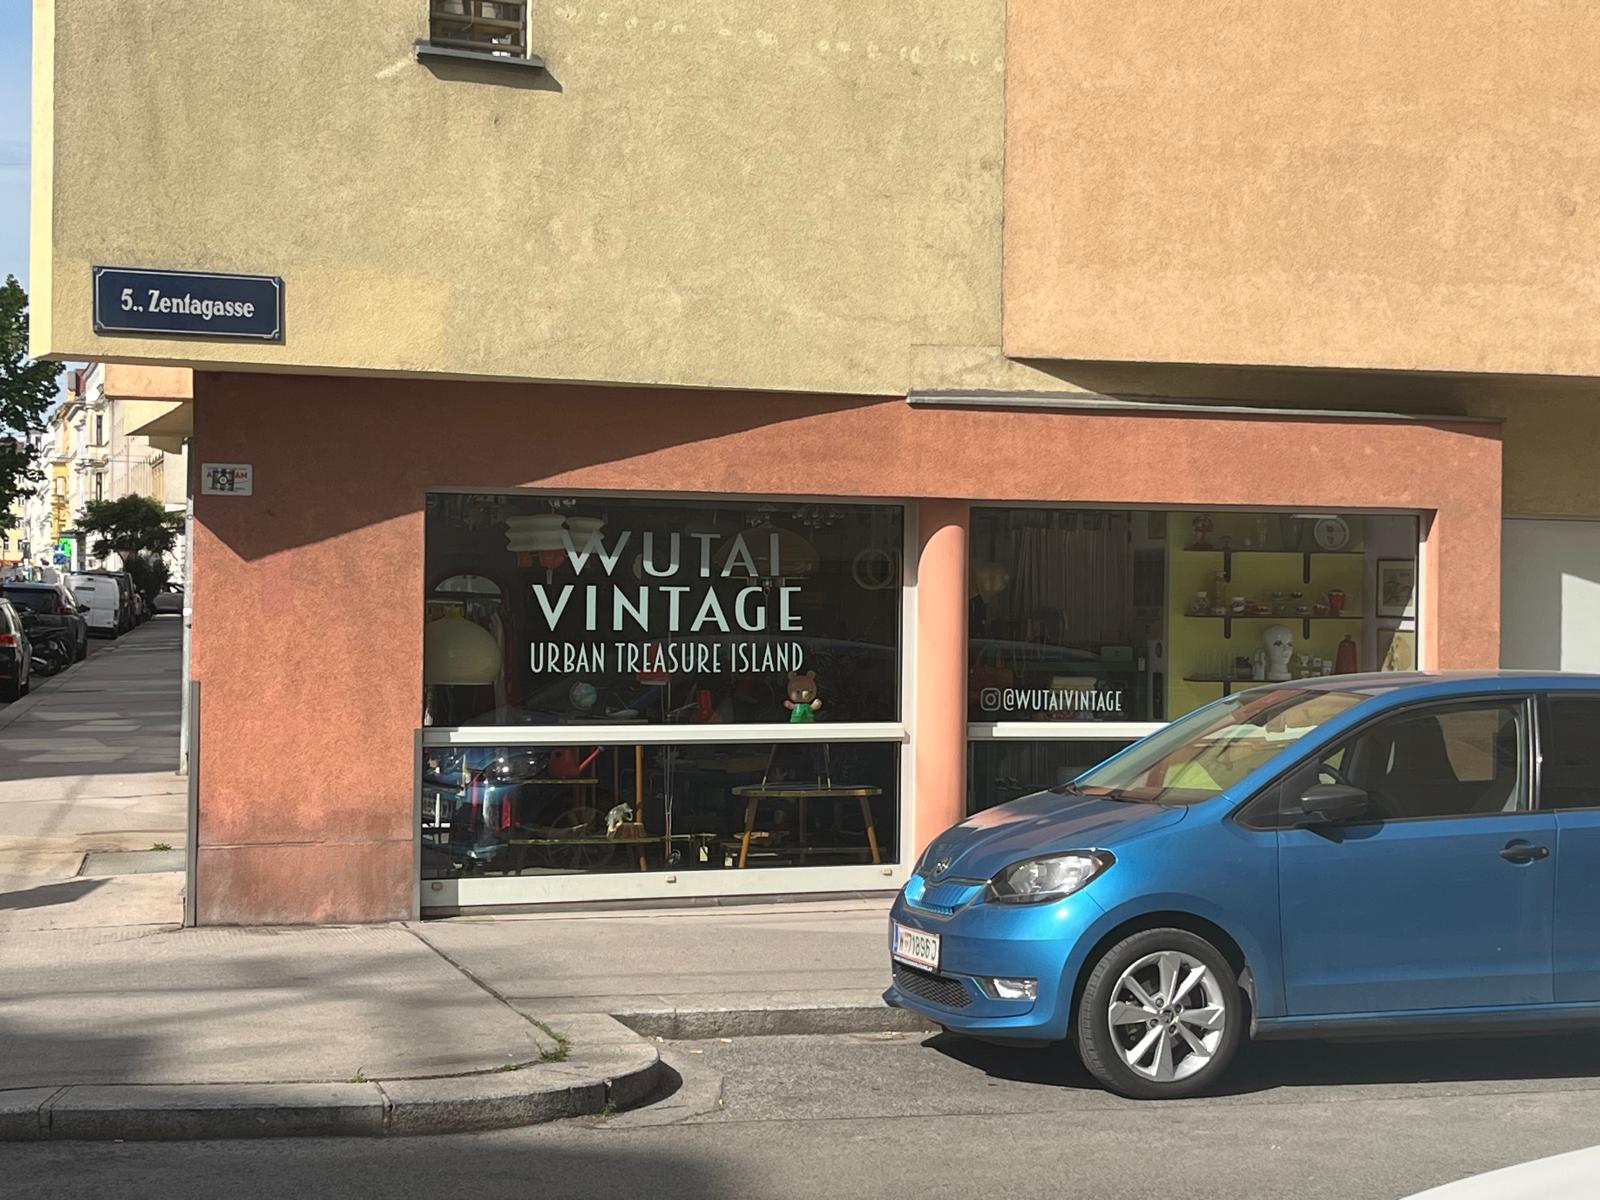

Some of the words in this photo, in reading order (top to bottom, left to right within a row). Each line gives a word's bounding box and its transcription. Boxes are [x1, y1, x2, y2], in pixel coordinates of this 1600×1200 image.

[148, 289, 255, 320] Zentagasse
[561, 531, 780, 577] WUTAI
[532, 584, 803, 632] VINTAGE
[530, 642, 605, 673] URBAN
[615, 642, 721, 673] TREASURE
[731, 642, 803, 673] ISLAND
[1003, 688, 1122, 711] @WUTAIVINTAGE
